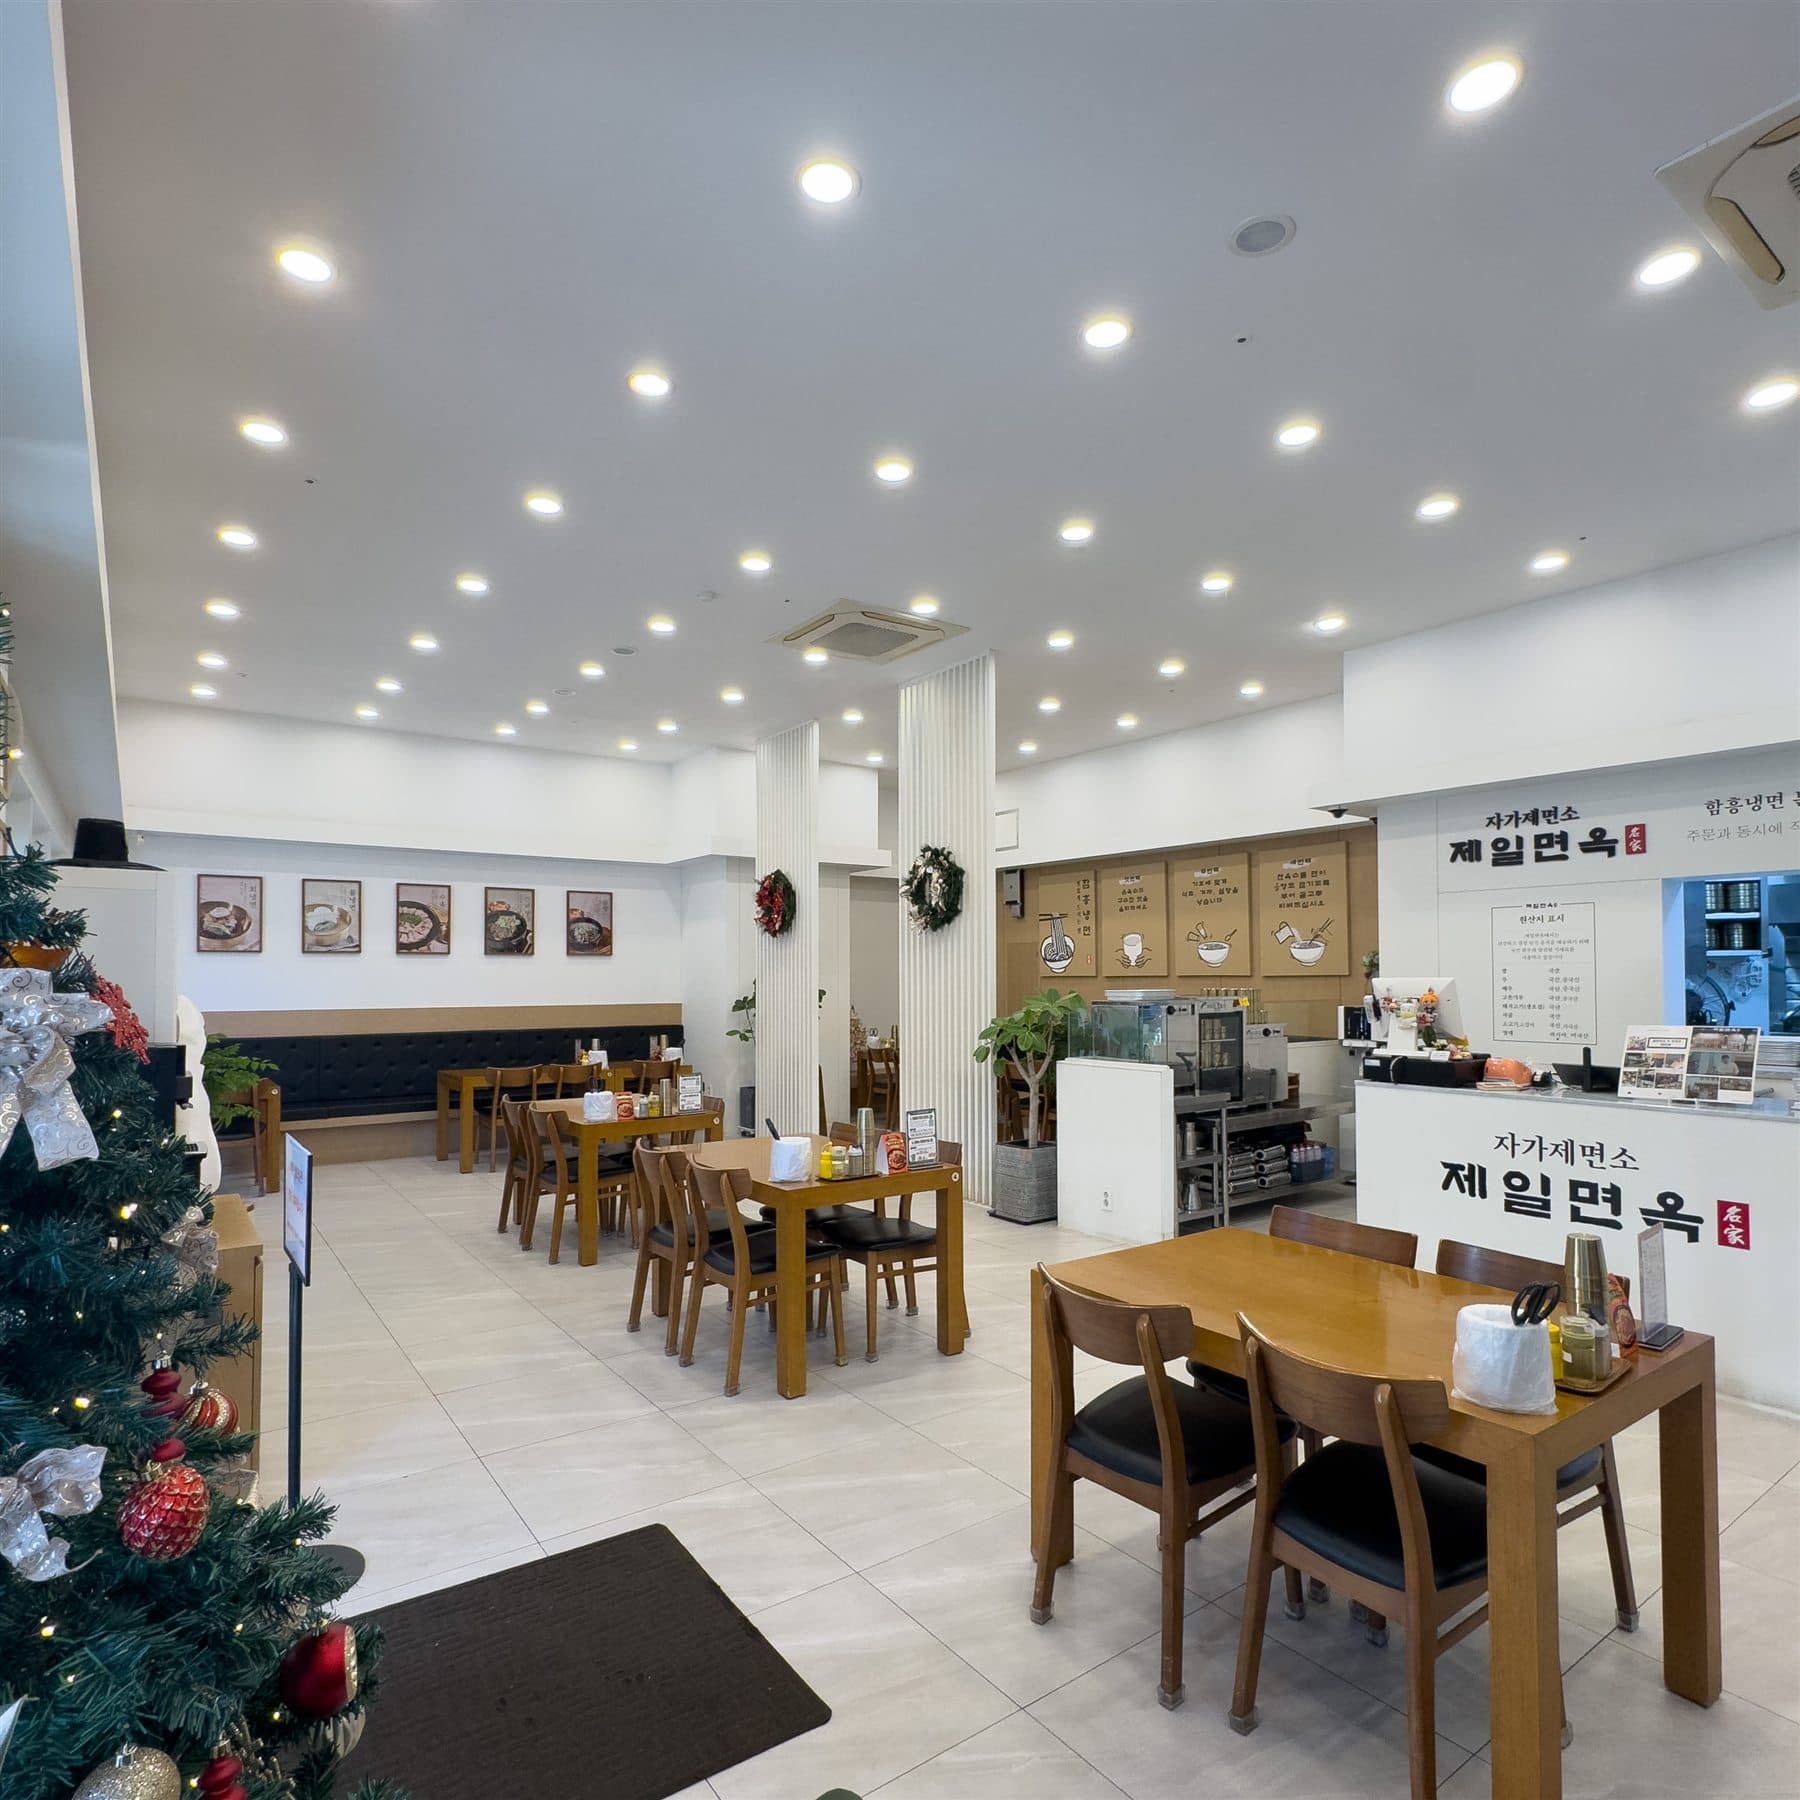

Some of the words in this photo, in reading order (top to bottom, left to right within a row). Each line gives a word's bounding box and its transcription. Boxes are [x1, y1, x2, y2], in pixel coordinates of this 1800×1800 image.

[1485, 806, 1580, 830] 자가제면소
[1704, 792, 1784, 816] 함흥냉면
[1449, 827, 1619, 867] 제일면옥
[1687, 827, 1731, 842] 주문과
[1736, 822, 1783, 838] 동시에
[1493, 1131, 1640, 1171] 자가제면소
[1440, 1160, 1704, 1244] 제일면옥
